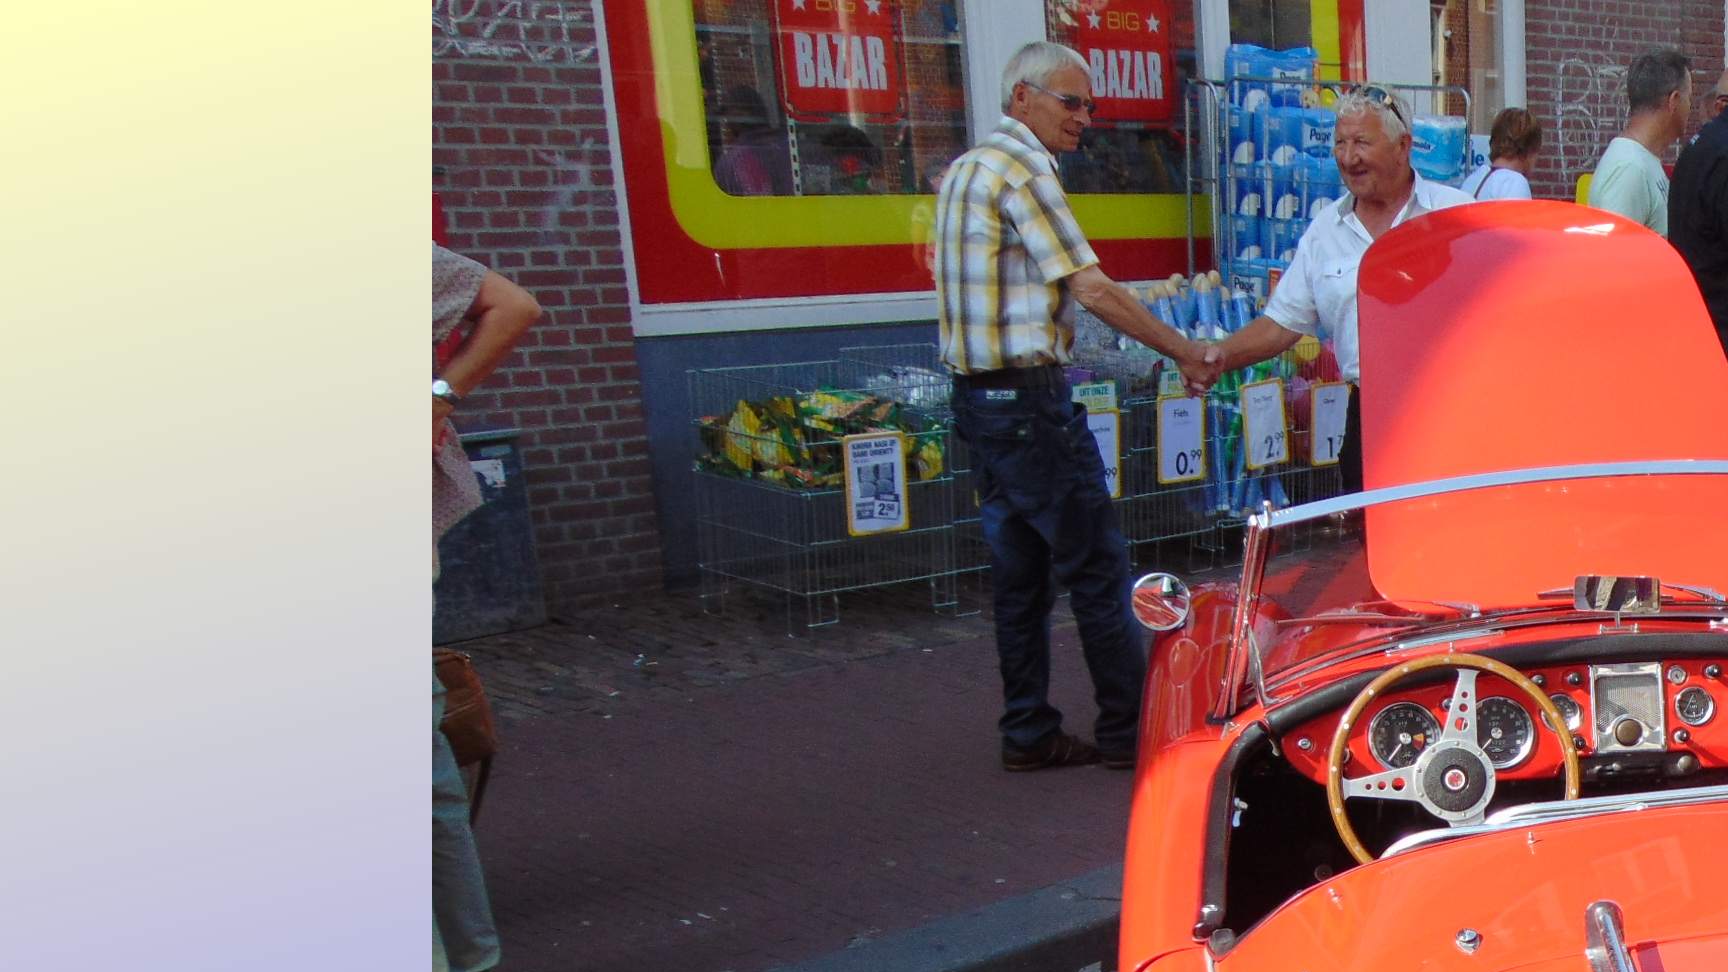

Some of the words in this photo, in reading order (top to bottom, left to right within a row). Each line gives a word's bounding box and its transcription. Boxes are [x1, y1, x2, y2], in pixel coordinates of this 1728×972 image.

[1107, 11, 1140, 31] BIG
[793, 31, 888, 90] BAZAR
[1089, 48, 1164, 99] BAZAR
